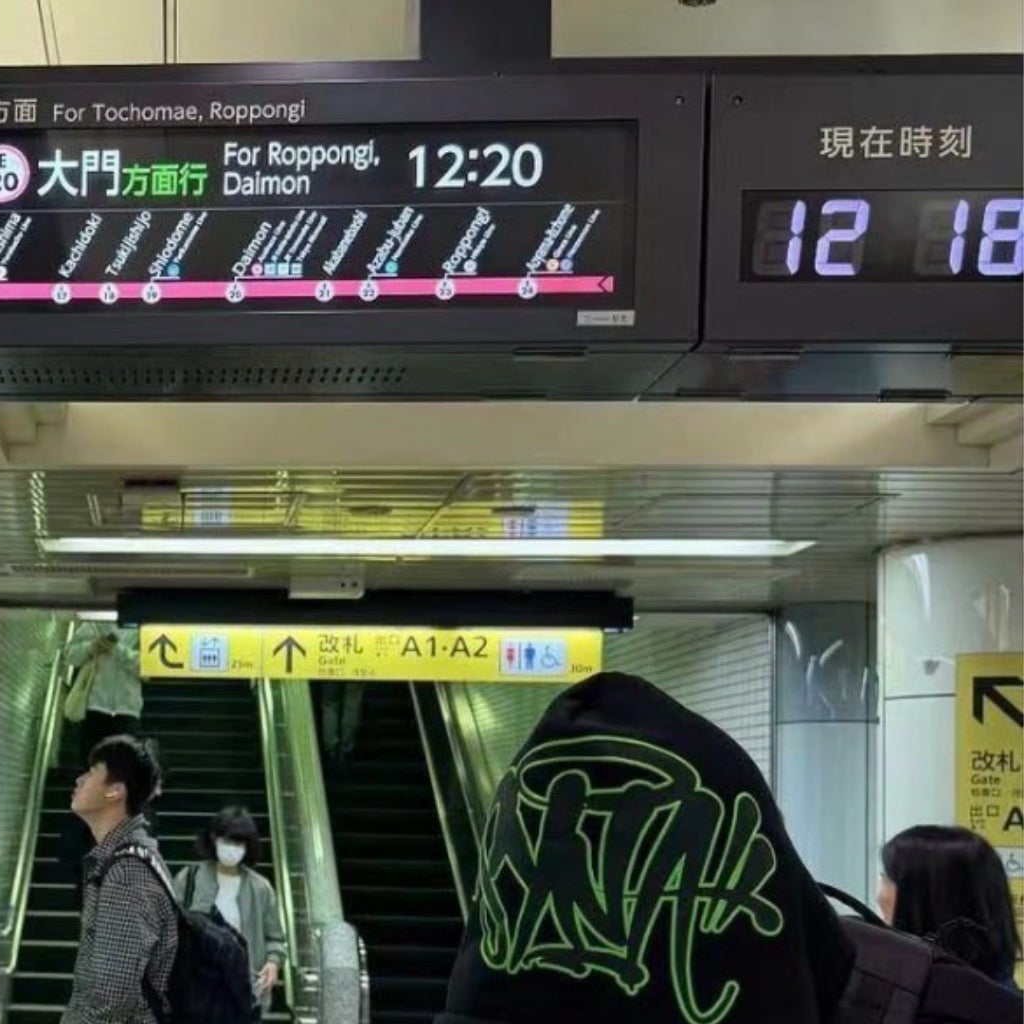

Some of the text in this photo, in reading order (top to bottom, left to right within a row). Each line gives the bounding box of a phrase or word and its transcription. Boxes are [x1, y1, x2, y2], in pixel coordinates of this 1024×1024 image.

[53, 99, 306, 127] For Tochomae, Roppongi
[224, 140, 380, 171] For Roppongi,
[820, 126, 973, 159] 現在時刻
[408, 143, 544, 188] 12:20
[223, 172, 310, 195] Daimon
[58, 212, 103, 278] Kachidoki
[105, 211, 152, 276] Tsukijishijo
[148, 212, 194, 277] Shiodome
[231, 221, 273, 276] Daimon
[442, 206, 491, 274] Roppongi
[318, 634, 364, 654] 改札
[971, 750, 1021, 772] 改札
[970, 774, 1001, 786] Gate
[970, 805, 1000, 817] 出口
